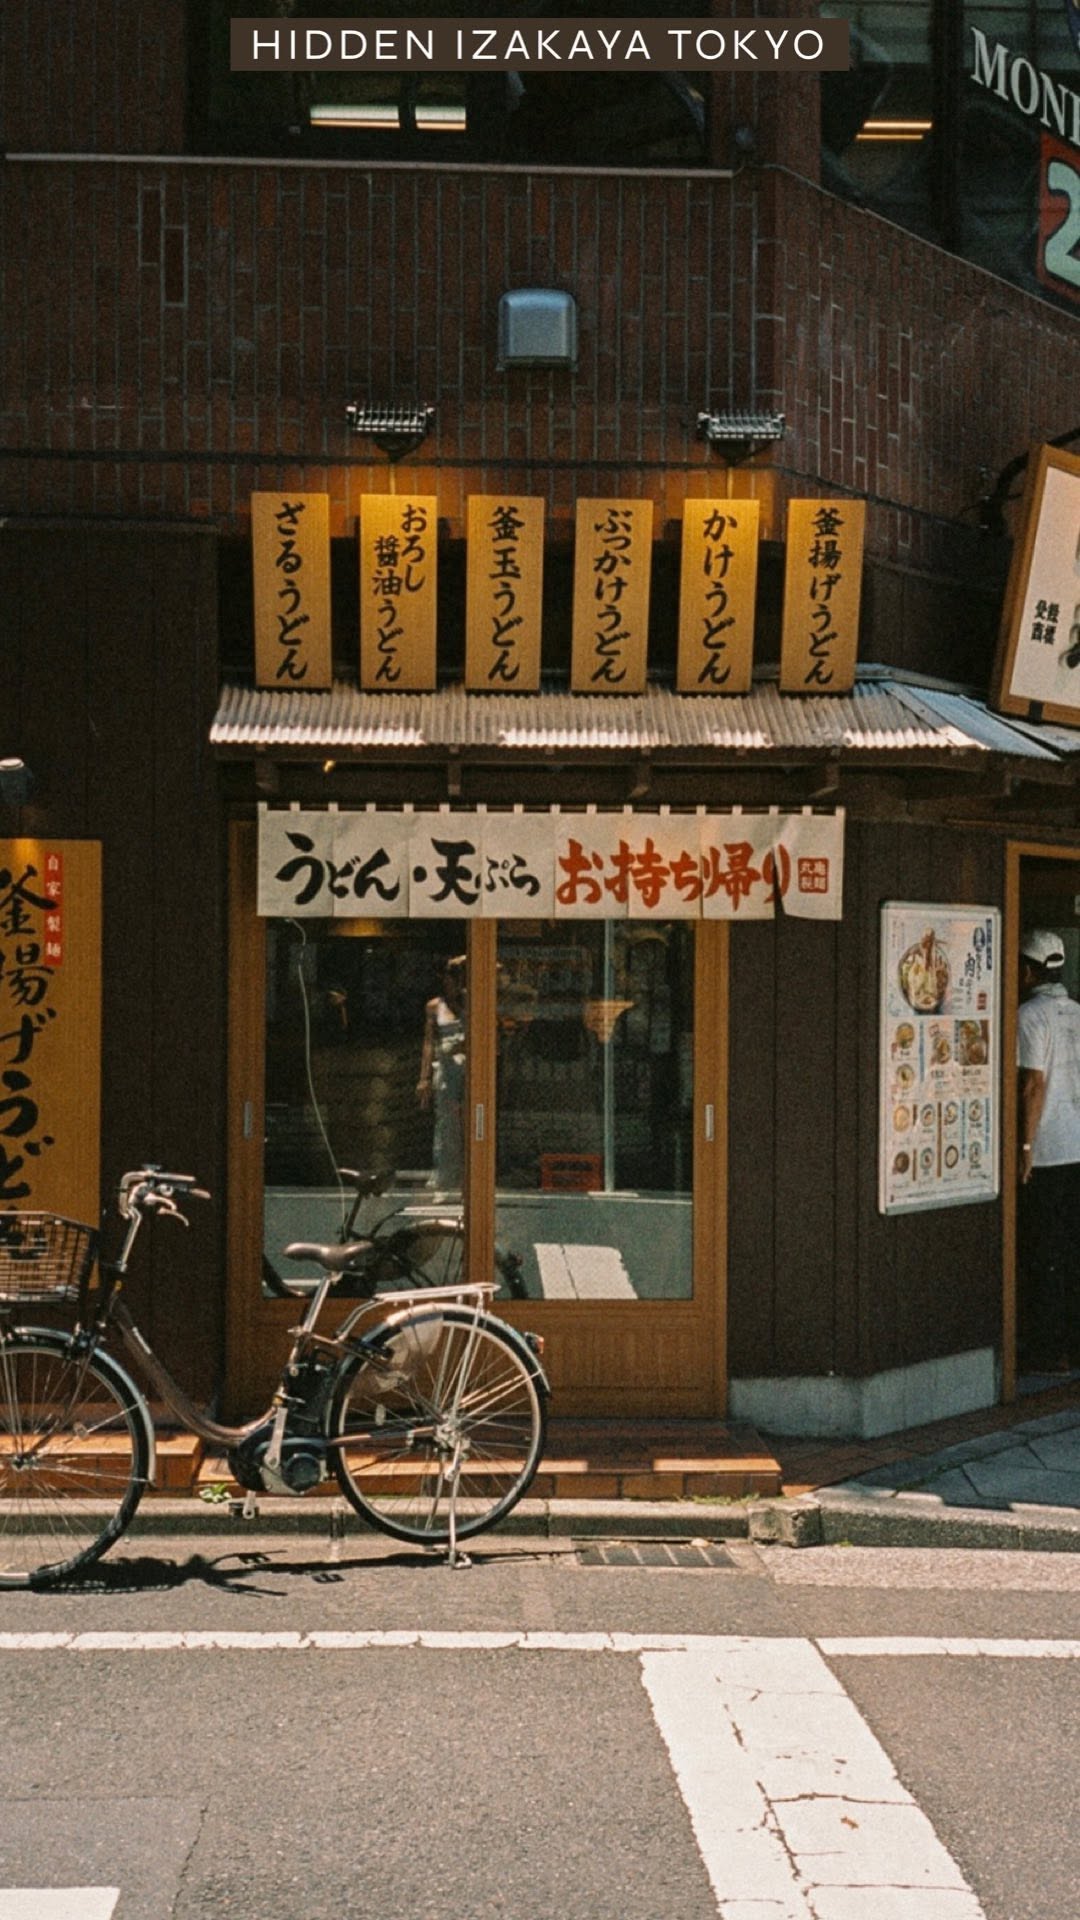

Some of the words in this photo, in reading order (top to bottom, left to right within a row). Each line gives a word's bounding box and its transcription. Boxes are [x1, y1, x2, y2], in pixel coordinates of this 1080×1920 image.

[274, 502, 310, 681] ざるうどん
[373, 535, 404, 682] 醤油うどん
[401, 504, 427, 592] おろし
[487, 506, 525, 682] 釜玉うどん
[590, 508, 633, 683] ぶっかけうどん
[698, 509, 738, 685] かけうどん
[804, 507, 845, 684] 釜揚げうどん
[556, 838, 791, 911] お持ち帰り
